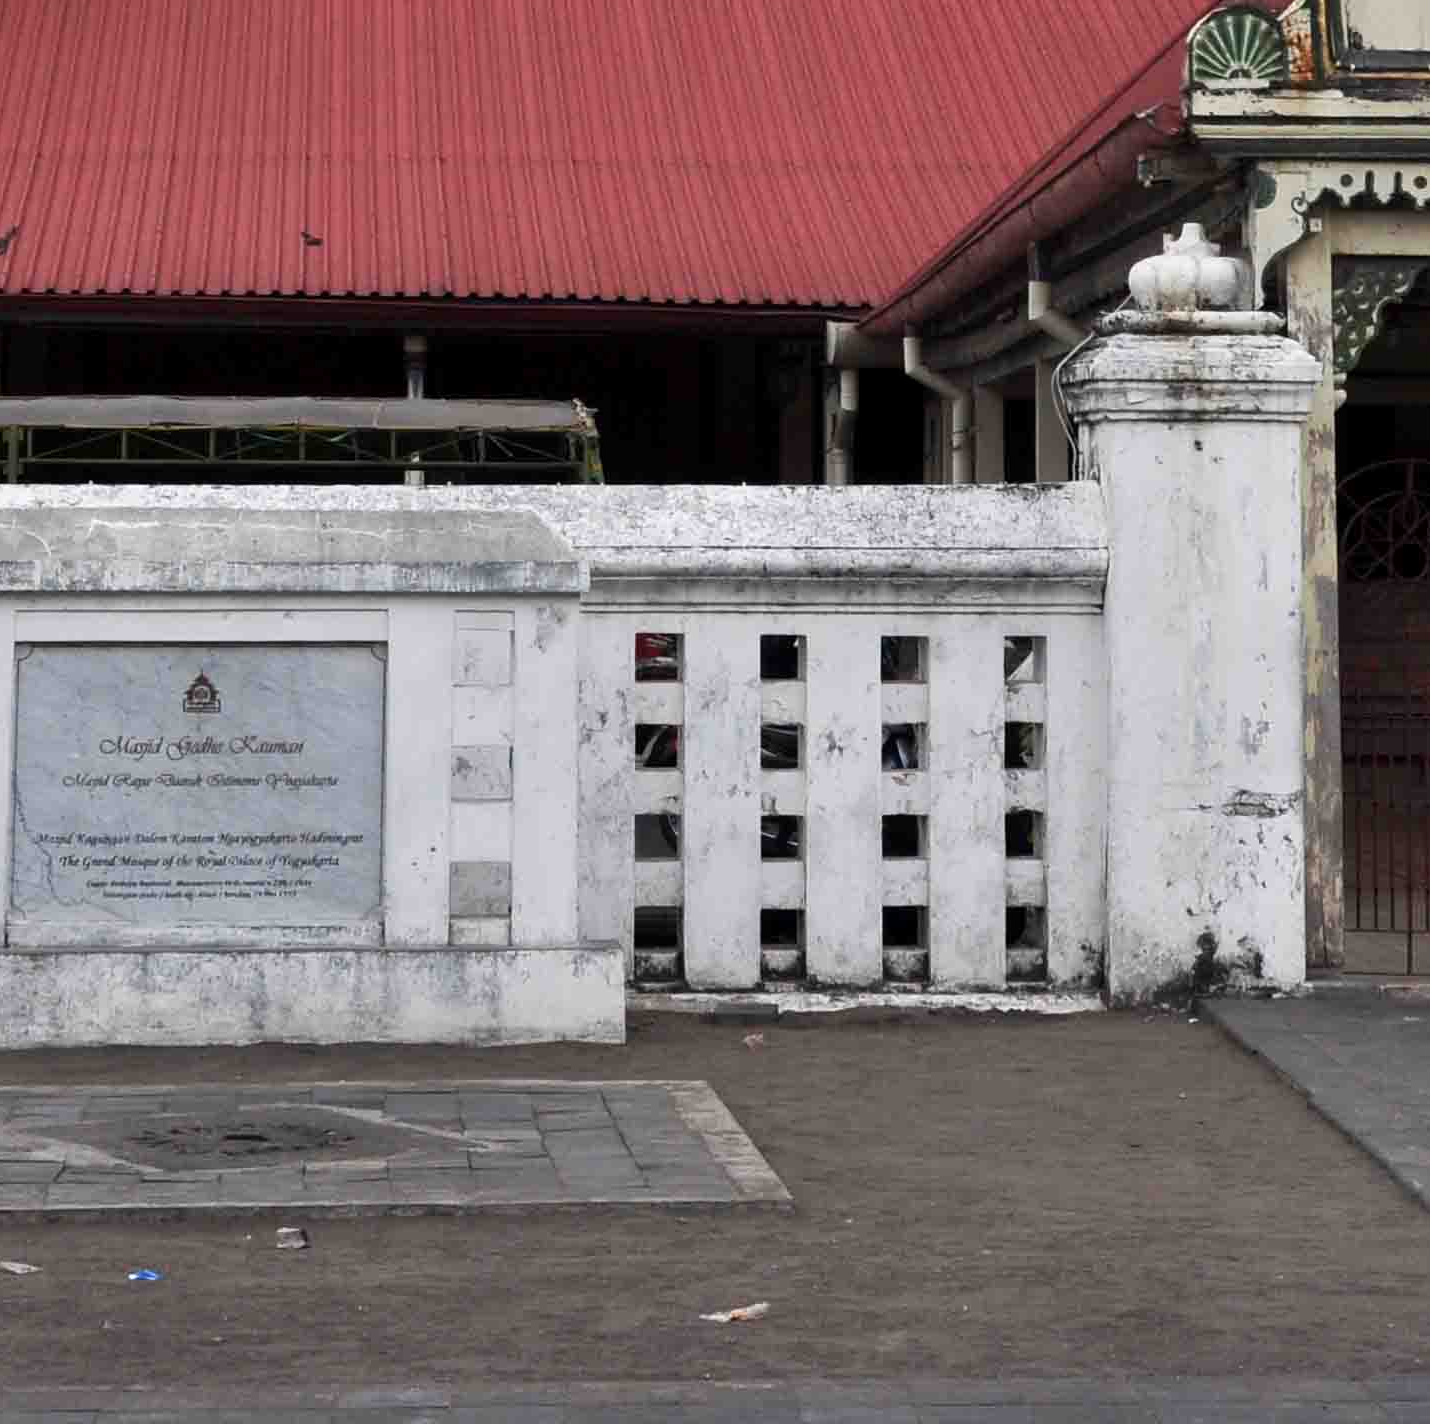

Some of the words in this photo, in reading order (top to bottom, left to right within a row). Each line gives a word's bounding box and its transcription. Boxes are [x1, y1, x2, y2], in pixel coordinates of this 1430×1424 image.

[99, 735, 164, 761] Masjid
[229, 734, 307, 754] Kauman
[59, 854, 80, 867] The
